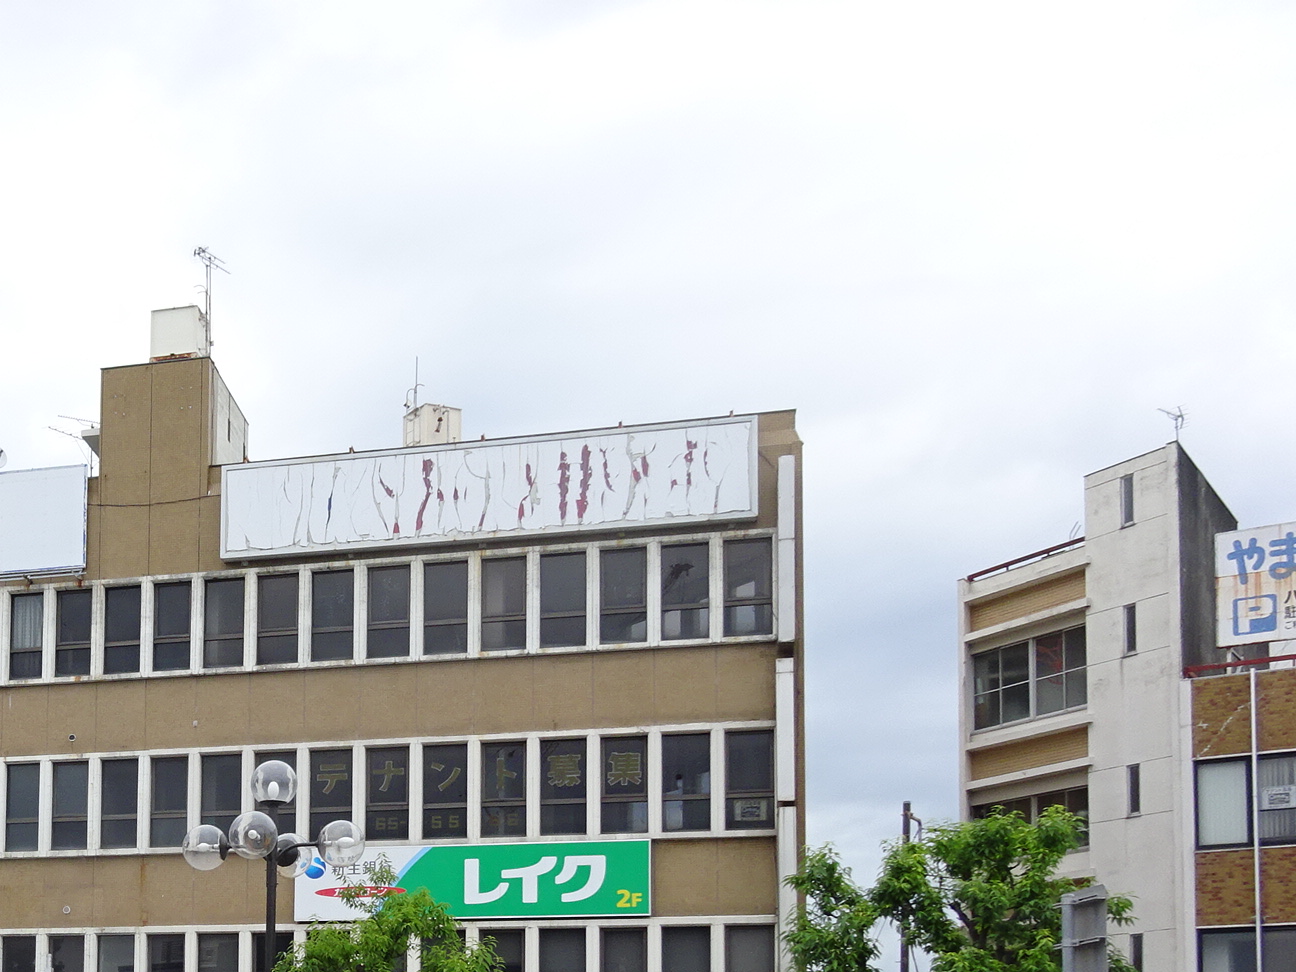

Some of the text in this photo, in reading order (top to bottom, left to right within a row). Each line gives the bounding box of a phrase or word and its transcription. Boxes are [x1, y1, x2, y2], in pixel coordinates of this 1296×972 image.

[1227, 532, 1296, 585] やま
[317, 752, 642, 795] テナント募集
[464, 855, 606, 904] レイク
[616, 889, 642, 908] 2F
